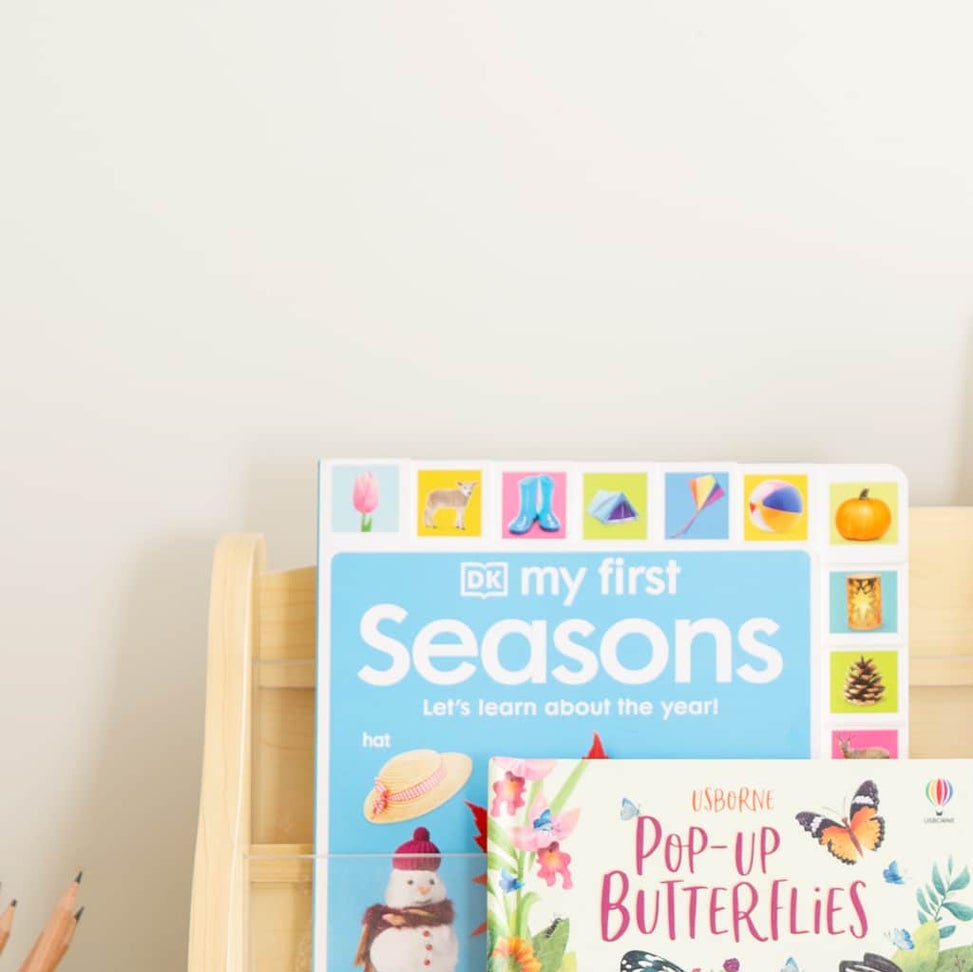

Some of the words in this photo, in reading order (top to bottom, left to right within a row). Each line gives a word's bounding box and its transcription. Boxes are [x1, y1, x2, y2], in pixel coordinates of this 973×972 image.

[466, 567, 501, 590] DK
[521, 567, 586, 606] my
[598, 558, 681, 596] first
[357, 604, 784, 687] Seasons
[423, 698, 471, 716] Let's
[478, 698, 537, 716] learn
[544, 698, 611, 716] about
[618, 698, 653, 715] the
[661, 698, 719, 720] year!
[362, 731, 391, 748] hat
[691, 787, 775, 812] USBORNE
[635, 815, 781, 876] POP-UP
[599, 870, 869, 944] BUTTERFLIES
